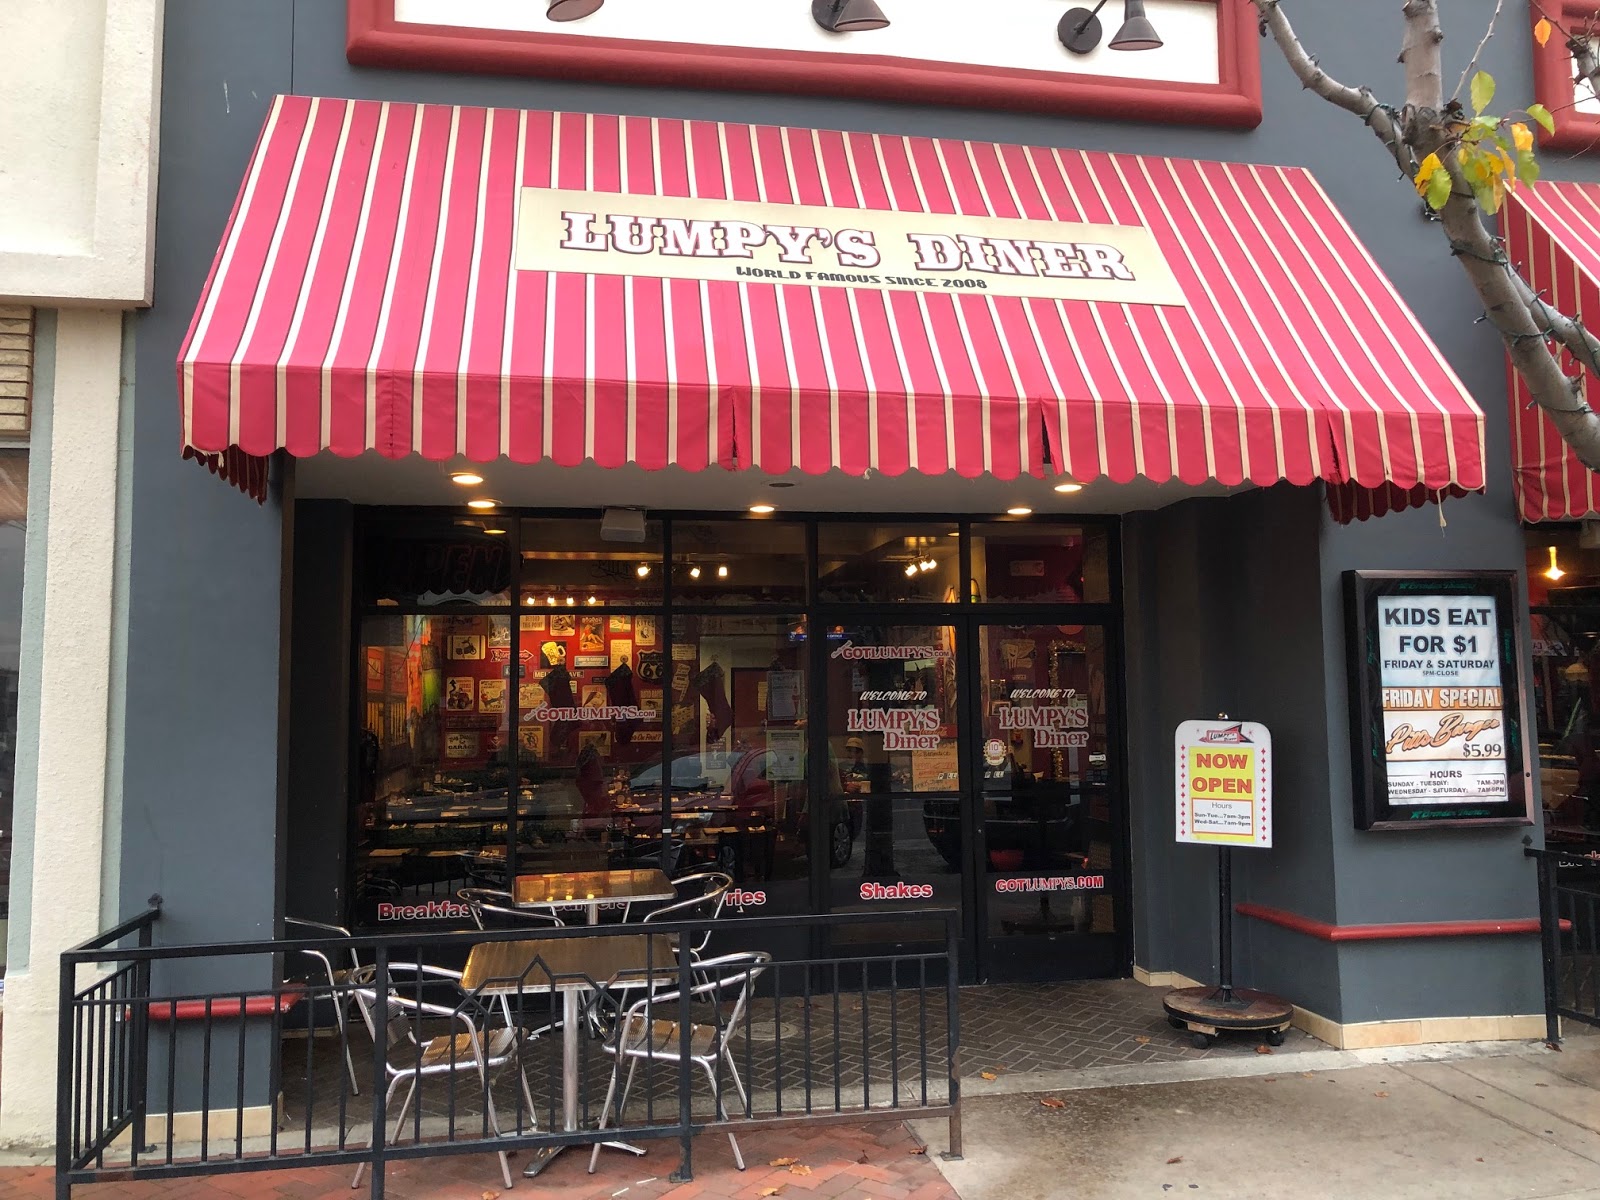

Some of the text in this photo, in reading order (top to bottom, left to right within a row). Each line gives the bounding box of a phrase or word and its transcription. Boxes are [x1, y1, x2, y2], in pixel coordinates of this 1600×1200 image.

[560, 211, 1136, 281] LUMPY'S DINER
[736, 266, 988, 289] WORLD FAMOUS SINCE 2008
[1384, 608, 1491, 626] KIDS EAT
[1399, 635, 1477, 655] FOR $1
[1384, 660, 1494, 668] FRIDAY & SATURDAY
[860, 690, 928, 701] WELCOME TO
[1010, 688, 1076, 699] WELCOME TO
[1382, 688, 1501, 708] FRIDAY SPECIAL
[848, 708, 940, 731] LUMPY'S
[999, 706, 1089, 729] LUMPY'S
[884, 731, 940, 750] Diner
[1035, 729, 1089, 748] Diner
[1463, 743, 1502, 758] $5.99
[1196, 753, 1248, 769] NOW
[1429, 771, 1463, 779] HOURS
[1192, 777, 1252, 794] OPEN
[860, 882, 933, 900] Shakes
[995, 876, 1104, 893] GOTLUMPYS.COM
[726, 888, 767, 907] ries
[378, 900, 476, 921] Breakfas
